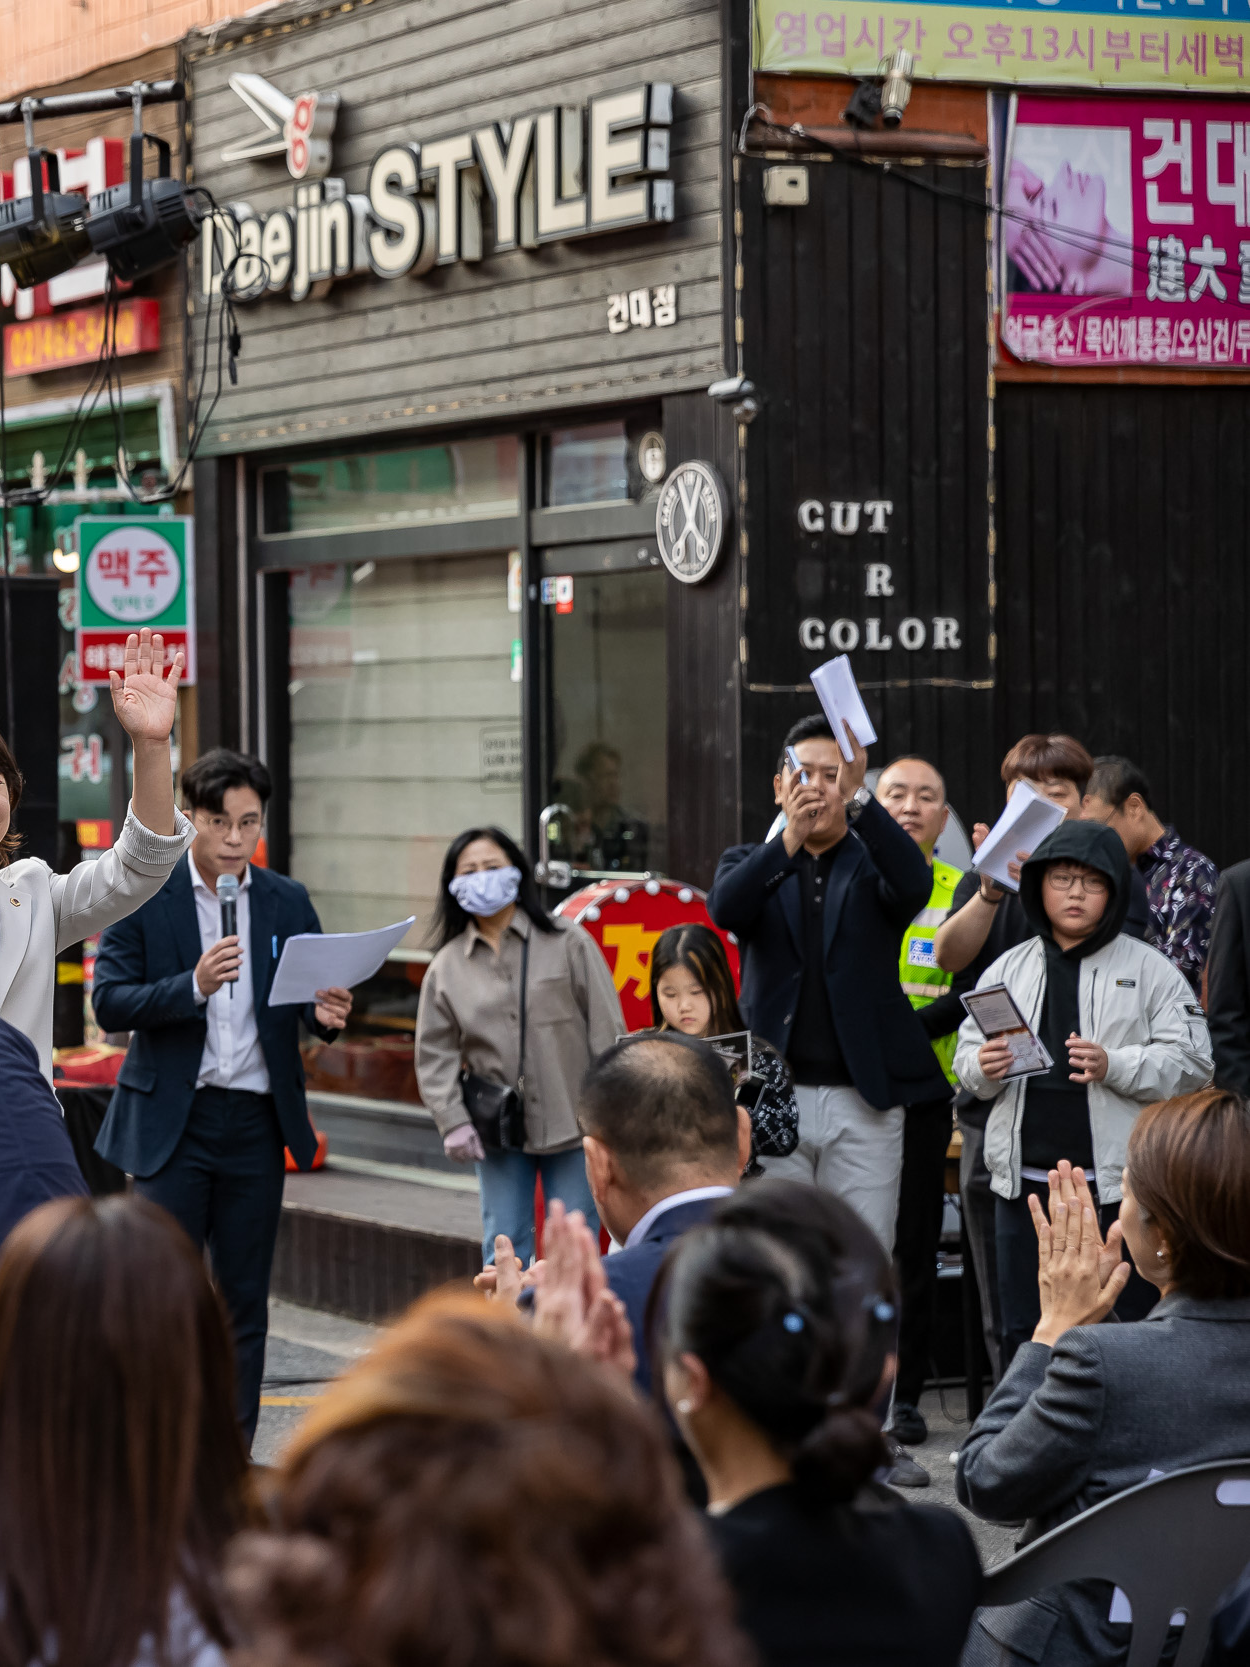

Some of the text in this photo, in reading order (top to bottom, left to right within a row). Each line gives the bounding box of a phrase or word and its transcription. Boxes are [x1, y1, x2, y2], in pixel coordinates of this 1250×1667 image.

[775, 11, 926, 61] 영업시간
[201, 180, 350, 301] Daejin
[368, 83, 658, 280] STYLE
[607, 284, 677, 335] 건대점
[797, 499, 893, 535] CUT
[96, 548, 171, 589] 맥주
[865, 562, 894, 597] R
[798, 616, 962, 652] COLOR
